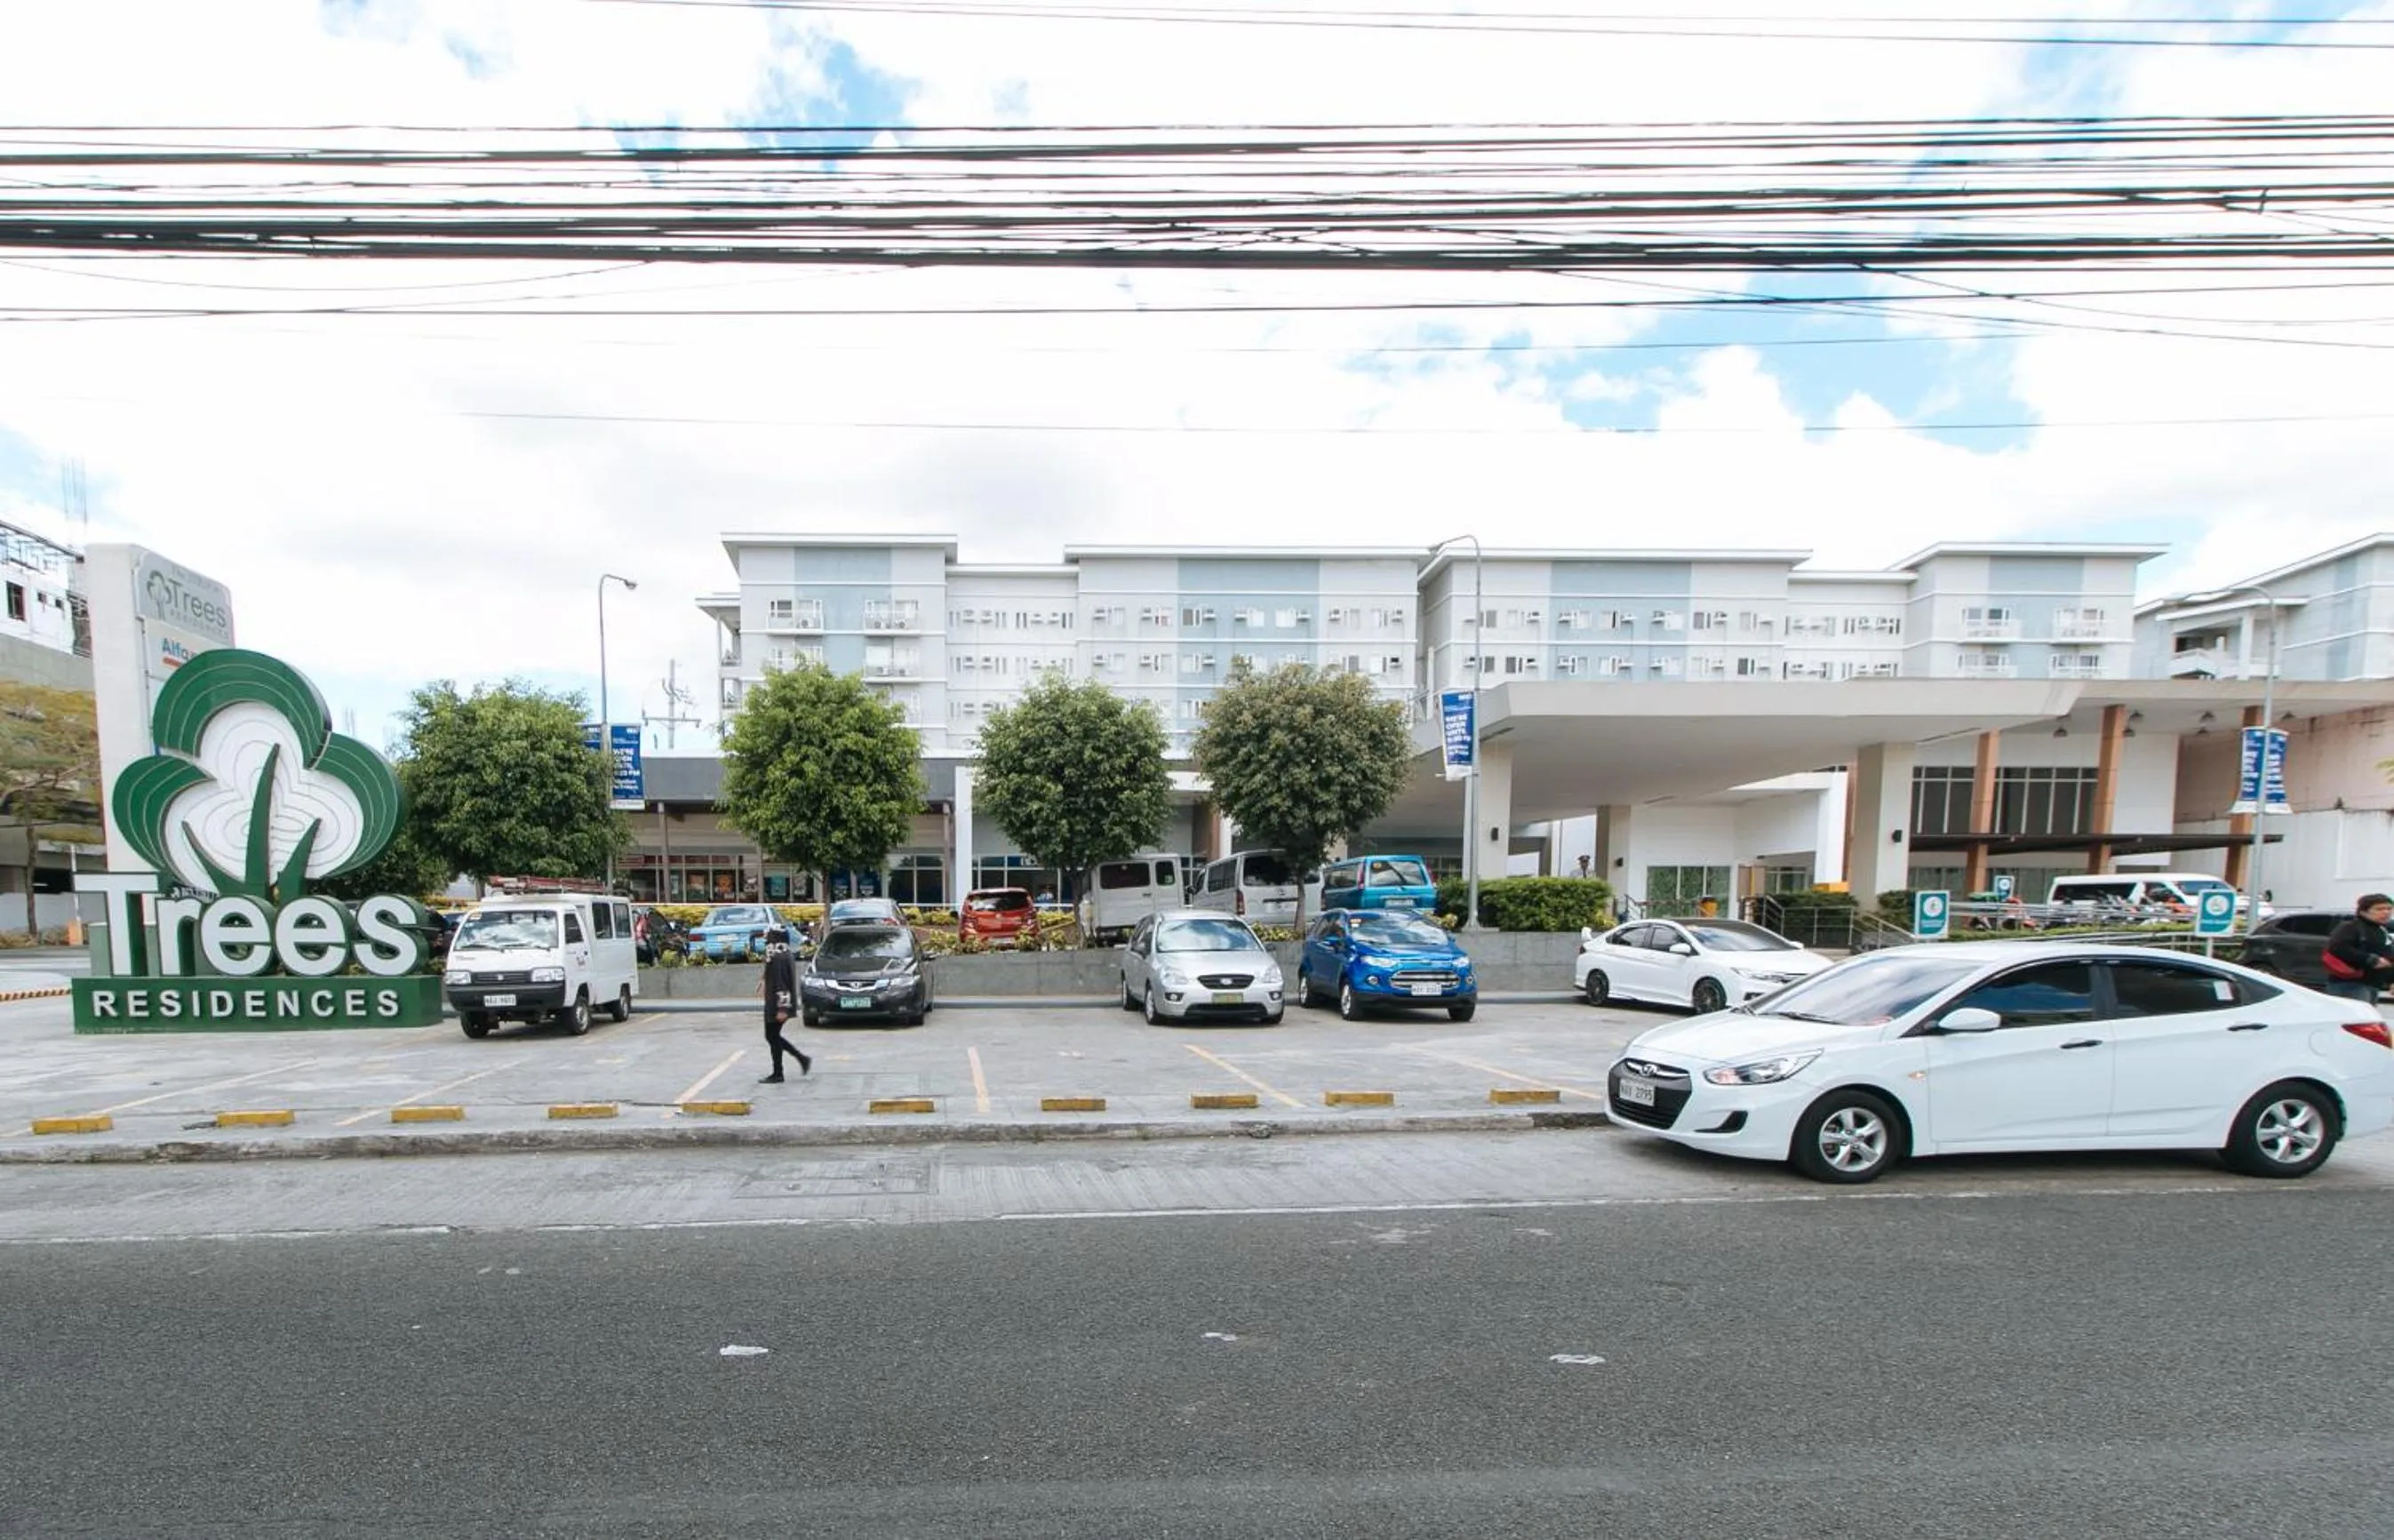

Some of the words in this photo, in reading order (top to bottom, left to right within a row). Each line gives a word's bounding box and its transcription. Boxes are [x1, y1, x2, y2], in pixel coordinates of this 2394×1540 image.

[167, 578, 227, 628] Trees
[75, 874, 419, 976] Trees
[92, 989, 400, 1017] RESIDENCES
